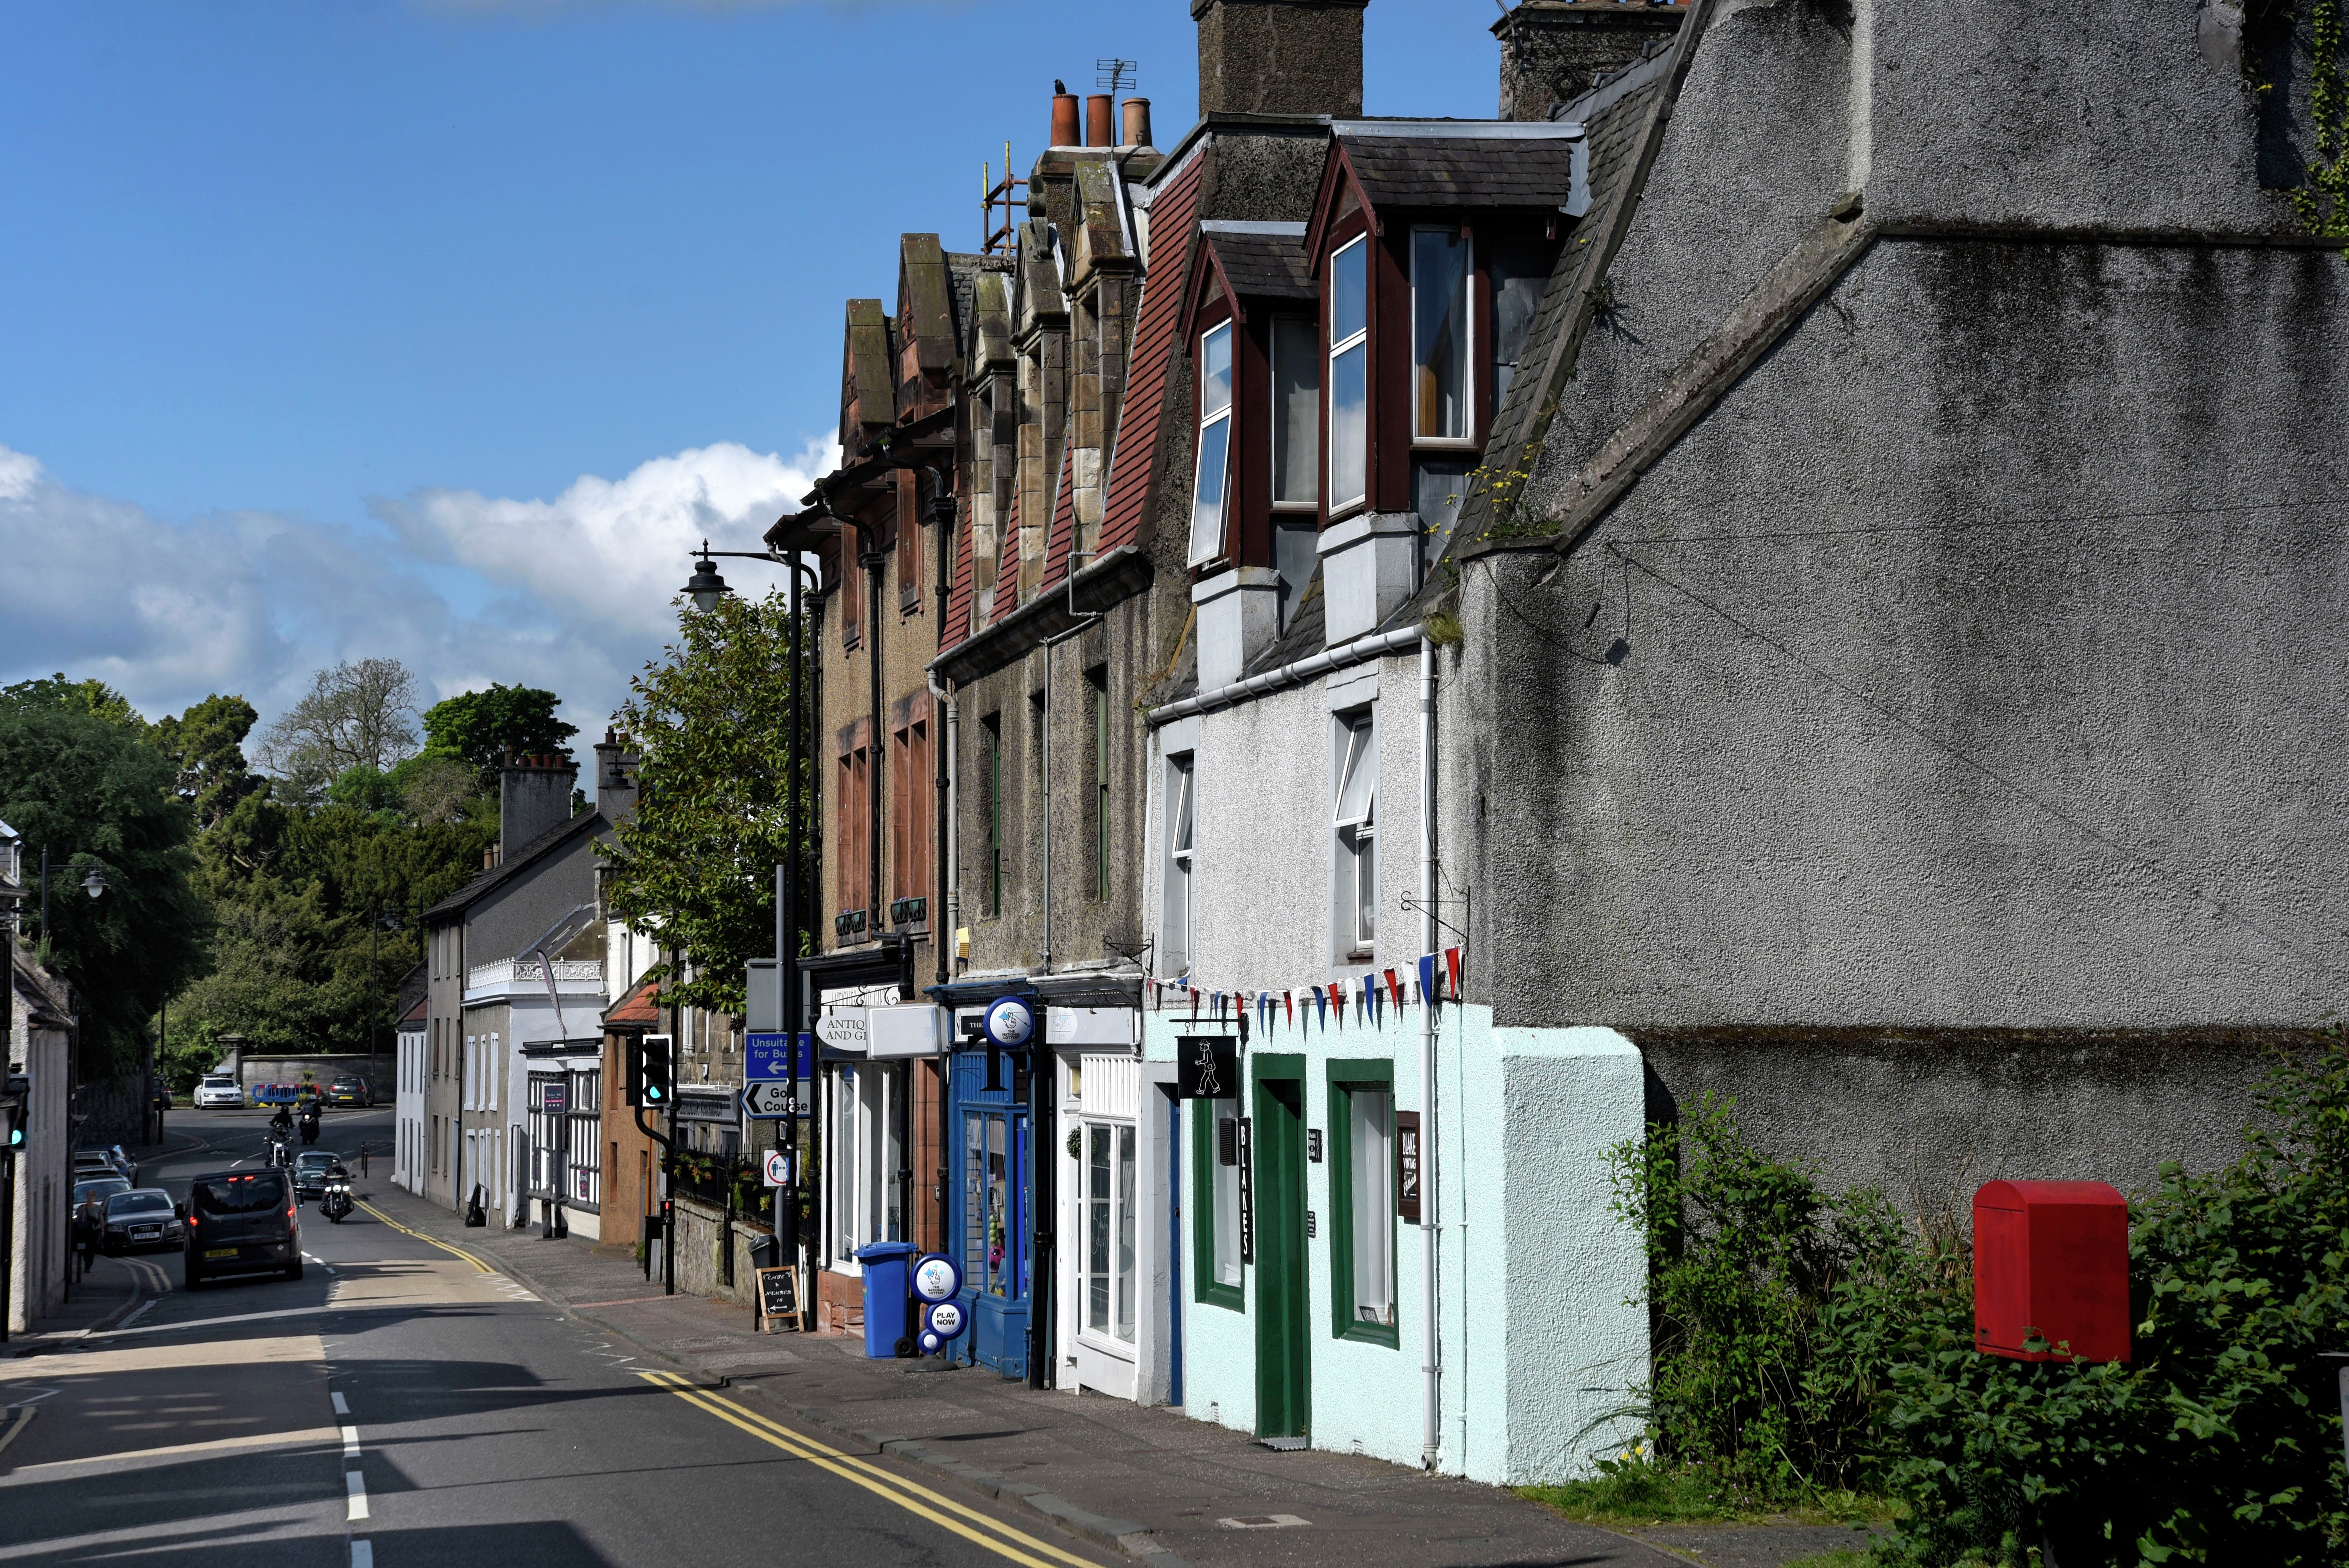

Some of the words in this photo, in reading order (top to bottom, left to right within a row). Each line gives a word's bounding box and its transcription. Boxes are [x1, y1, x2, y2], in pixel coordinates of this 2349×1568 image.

[827, 1020, 865, 1030] ANTIQ
[826, 1031, 851, 1040] AND
[752, 1038, 805, 1047] Unsuitae
[754, 1050, 768, 1058] for
[773, 1049, 803, 1058] Bus
[770, 1088, 787, 1098] Go
[764, 1101, 808, 1111] Couse
[1402, 1133, 1416, 1155] BLAKE
[1403, 1158, 1416, 1169] VINTAG
